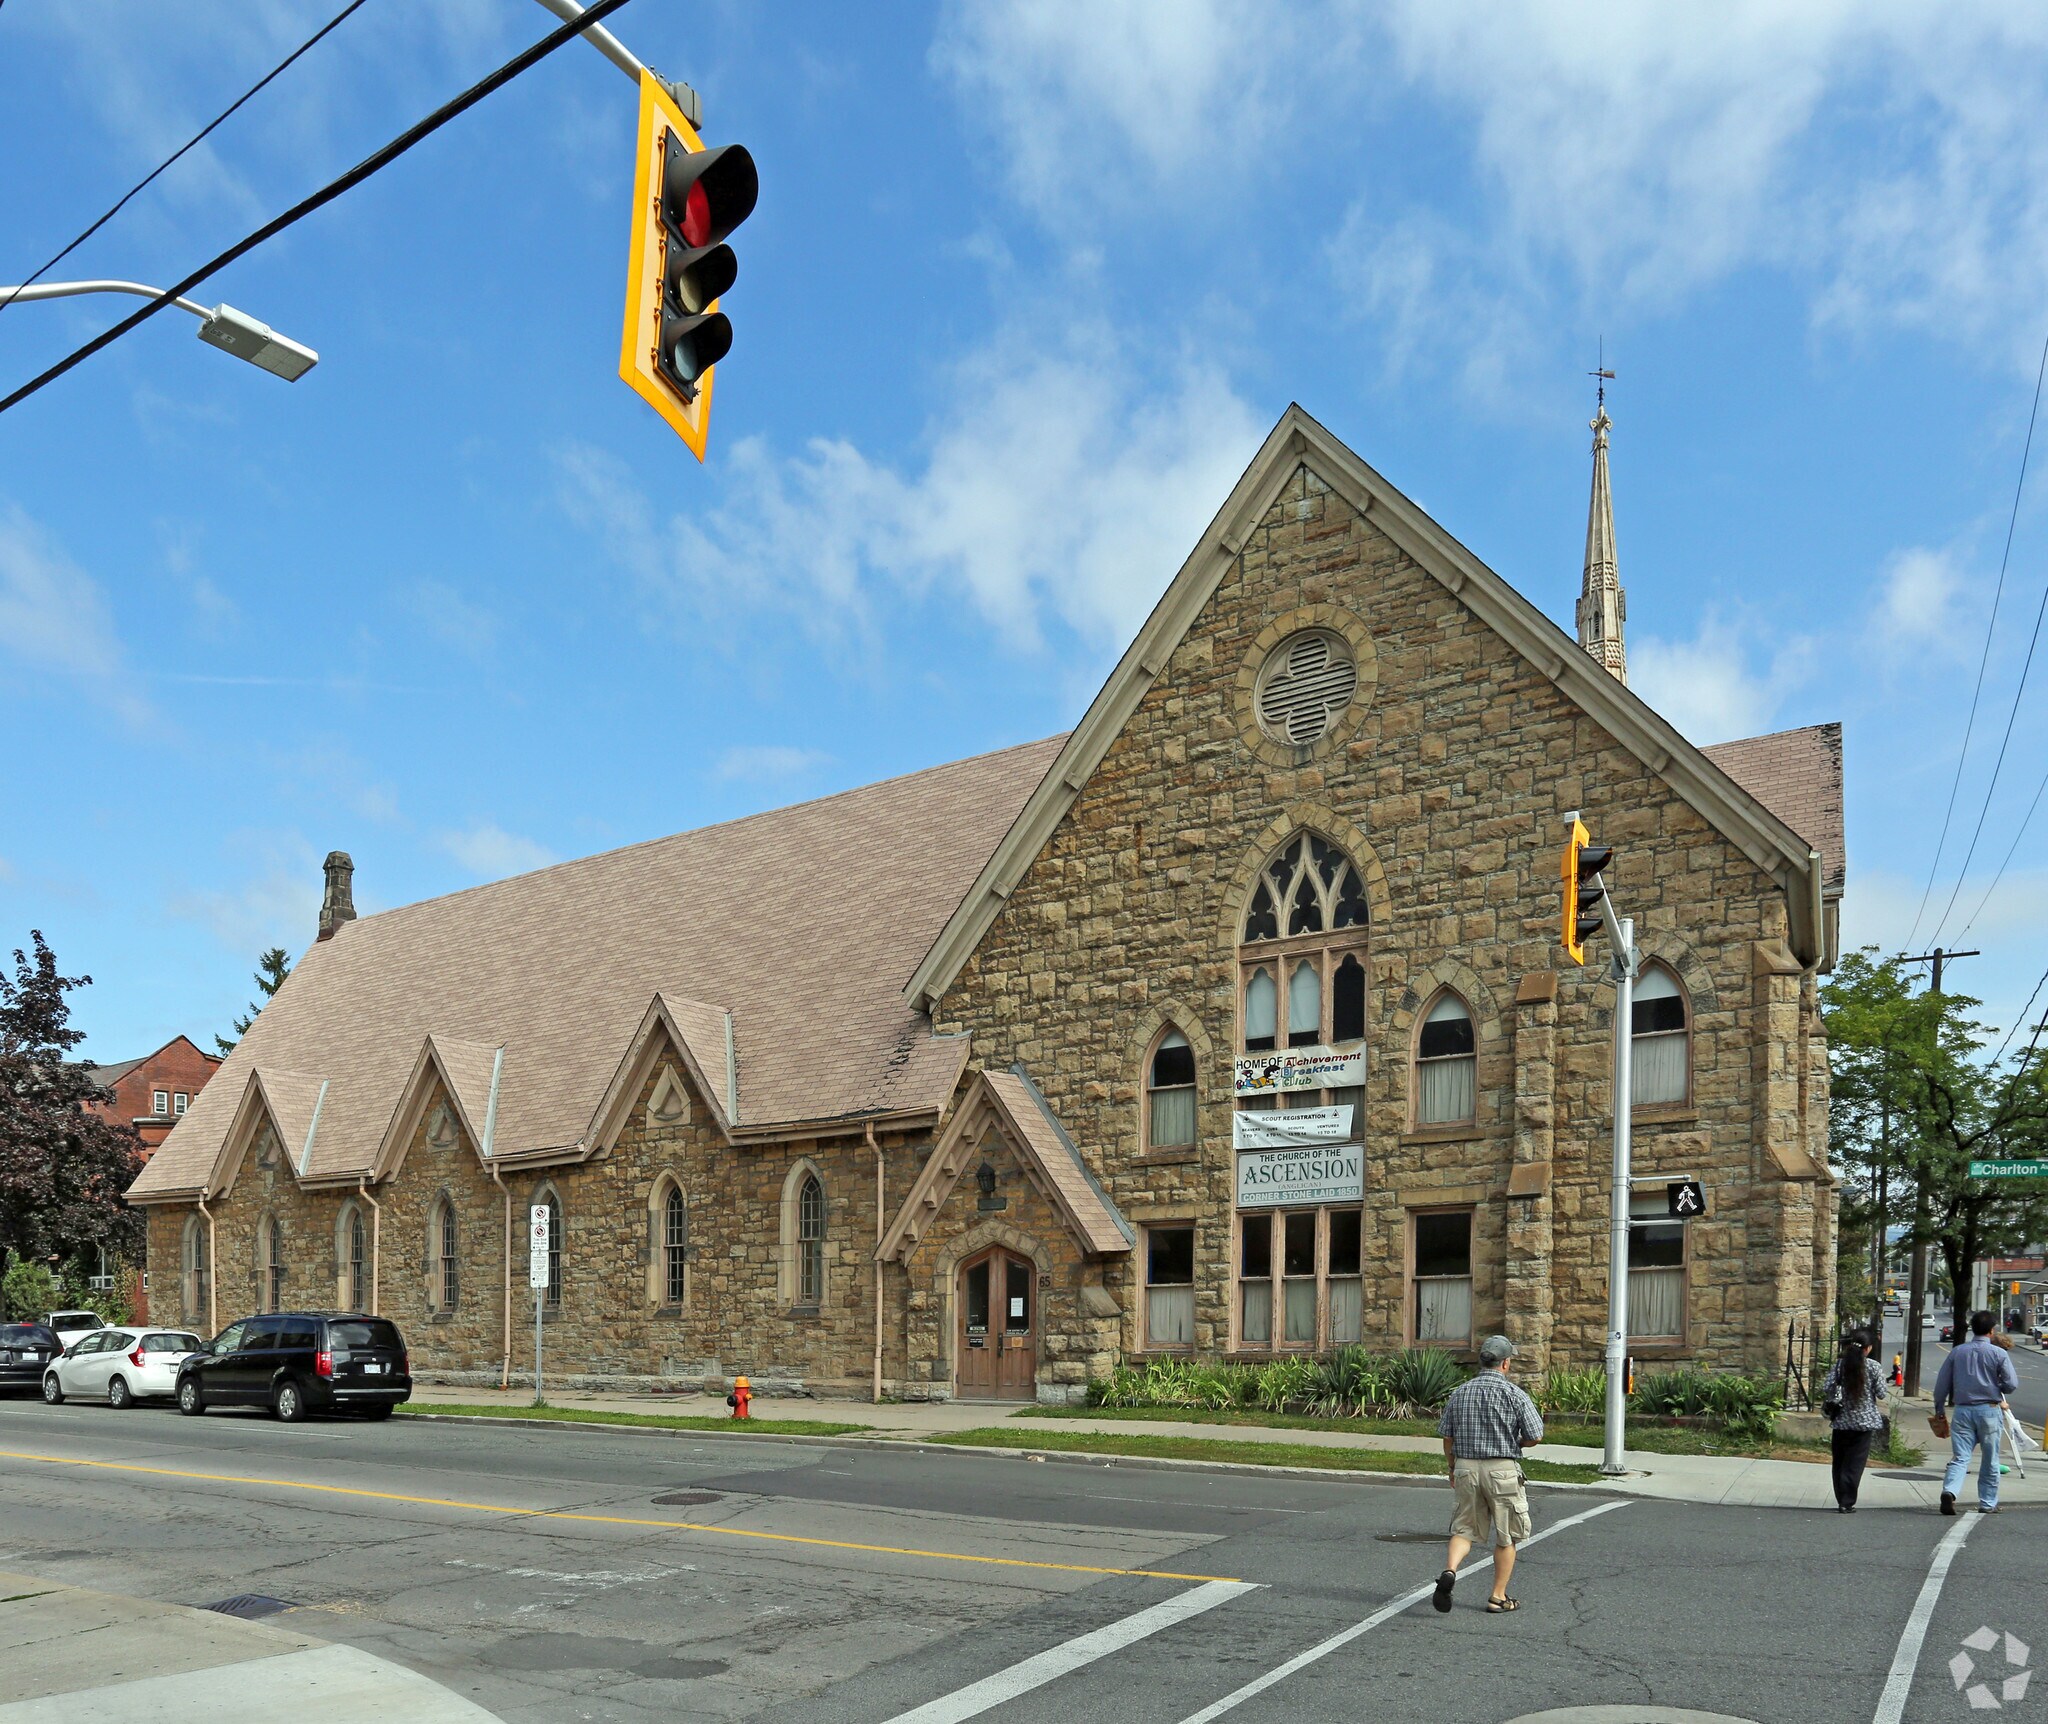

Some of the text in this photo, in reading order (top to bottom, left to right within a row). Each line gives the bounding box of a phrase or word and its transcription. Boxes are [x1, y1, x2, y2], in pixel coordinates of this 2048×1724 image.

[1236, 1052, 1362, 1070] HOME OF Achievement
[1281, 1063, 1345, 1078] Breakfast
[1282, 1077, 1312, 1087] Club
[1282, 1113, 1326, 1121] REGISTRATION
[1260, 1149, 1341, 1162] THE CHURCH OF THE
[1244, 1158, 1358, 1184] ASCENSION
[1982, 1163, 2038, 1175] Charlton
[1278, 1181, 1322, 1190] (ANGLICAN)
[1243, 1186, 1358, 1202] CORNER STONE LAID 1850
[1039, 1275, 1051, 1288] 65
